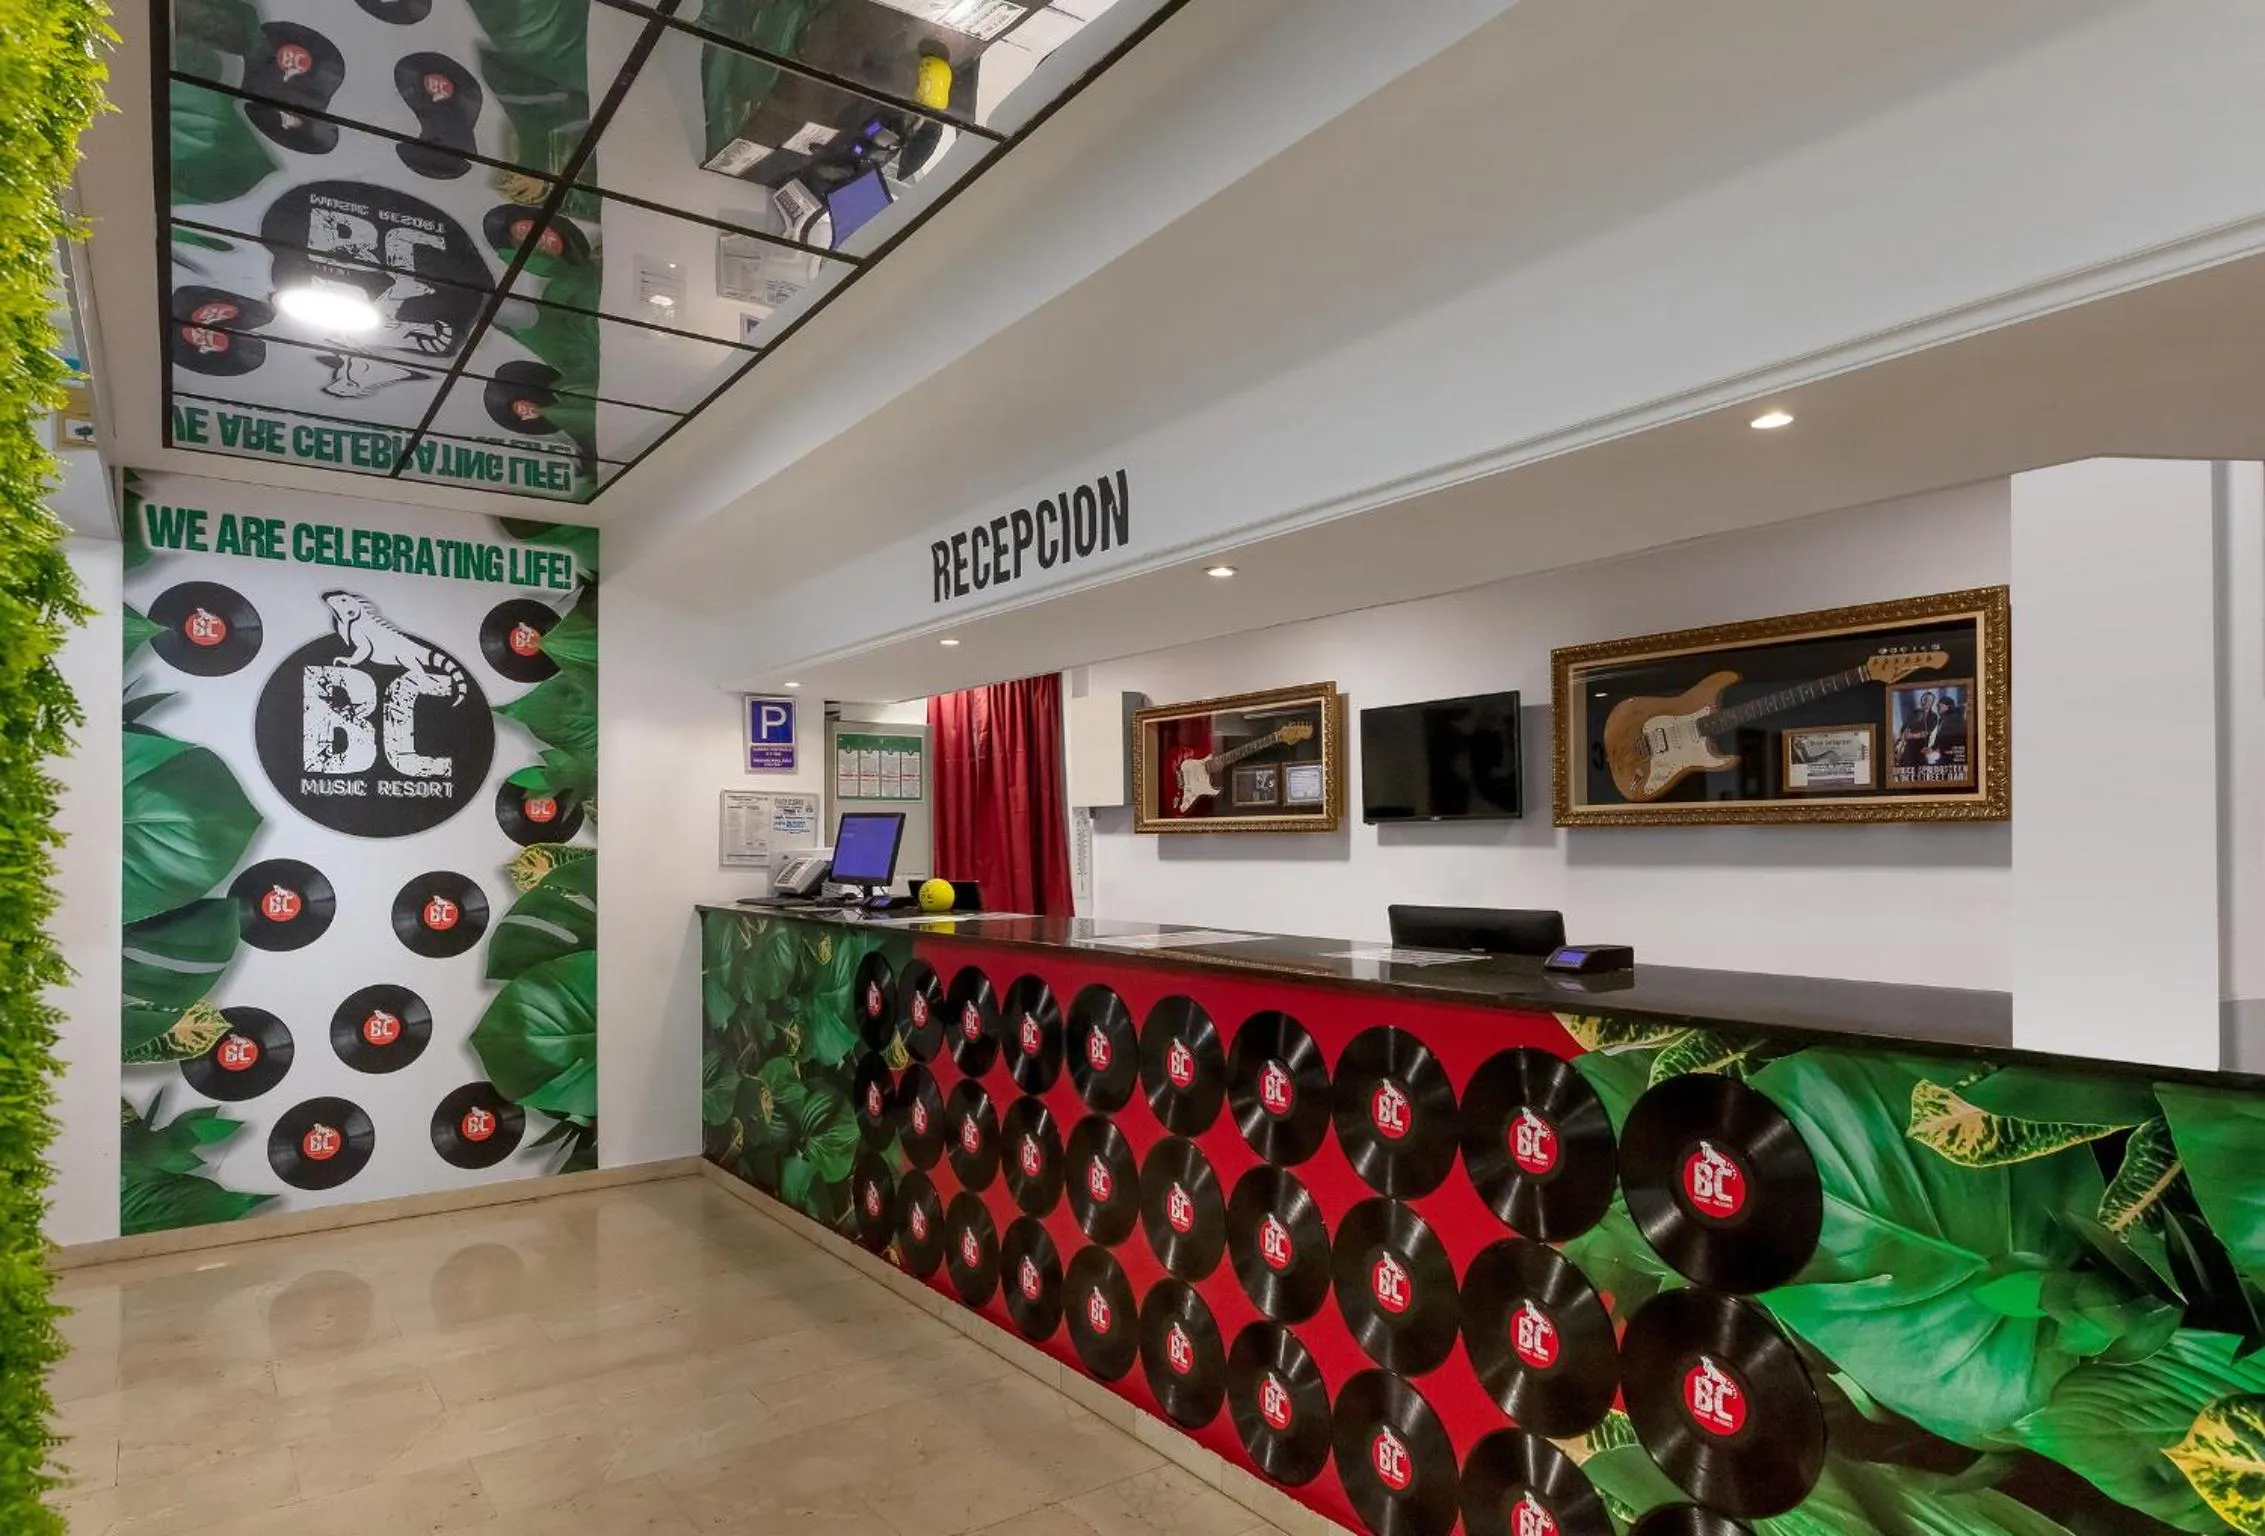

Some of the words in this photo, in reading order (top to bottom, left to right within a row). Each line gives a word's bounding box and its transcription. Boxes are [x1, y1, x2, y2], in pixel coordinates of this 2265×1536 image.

[145, 503, 208, 551] WE
[215, 513, 286, 560] ARE
[292, 522, 504, 582] CELEBRATING
[509, 548, 573, 590] LIFE!
[931, 469, 1129, 602] RECEPCION
[193, 618, 218, 637] BC
[303, 665, 452, 778] BC
[761, 706, 787, 739] P
[301, 779, 367, 797] MUSIC
[377, 779, 455, 798] RESORT
[270, 894, 293, 912] BC
[430, 903, 452, 921] BC
[370, 1019, 391, 1037] BC
[965, 1010, 977, 1031] BC
[1023, 1023, 1037, 1043] BC
[225, 1045, 250, 1063] BC
[1091, 1039, 1106, 1060] BC
[1171, 1052, 1188, 1077] BC
[1265, 1076, 1285, 1102] BC
[1379, 1094, 1403, 1126] BC
[468, 1116, 488, 1133] BC
[965, 1124, 976, 1146] BC
[310, 1134, 333, 1151] BC
[1516, 1125, 1548, 1159] BC
[1023, 1144, 1036, 1167] BC
[1092, 1168, 1106, 1192] BC
[1694, 1162, 1733, 1201] BC
[1171, 1194, 1188, 1223] BC
[964, 1238, 975, 1260] BC
[1265, 1228, 1286, 1258] BC
[1023, 1266, 1036, 1290] BC
[1379, 1266, 1403, 1302] BC
[1091, 1299, 1106, 1324] BC
[1518, 1316, 1549, 1356] BC
[1171, 1334, 1188, 1364] BC
[1265, 1386, 1285, 1419] BC
[1694, 1375, 1733, 1421] BC
[1379, 1441, 1403, 1478] BC
